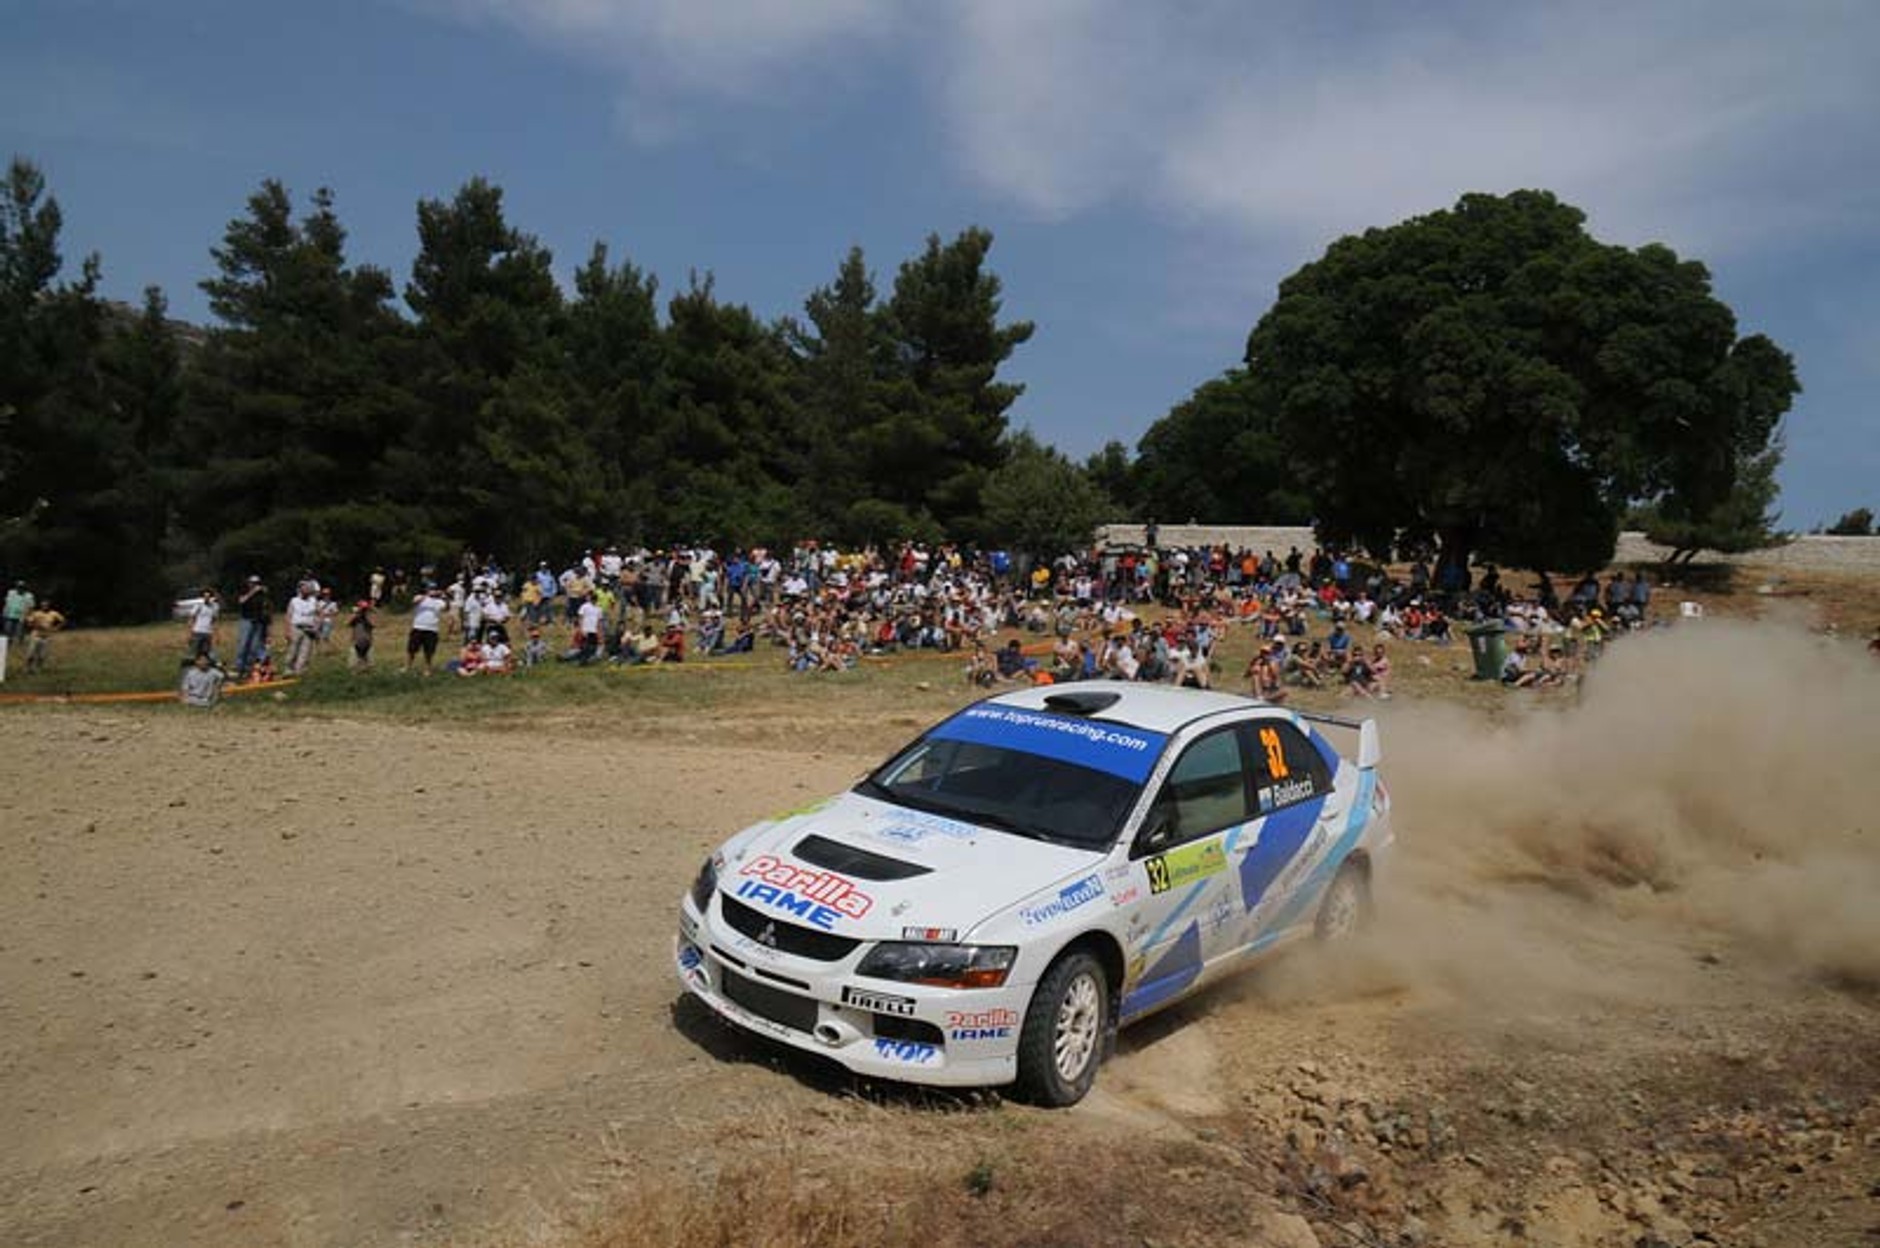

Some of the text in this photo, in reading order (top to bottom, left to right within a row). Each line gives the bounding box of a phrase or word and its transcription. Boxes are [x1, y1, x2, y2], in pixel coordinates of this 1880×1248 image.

[965, 707, 1148, 752] www.toprunracing.com
[1258, 727, 1289, 780] 32
[738, 855, 874, 920] Parilla
[1146, 857, 1169, 892] 32
[737, 880, 843, 930] IAME
[845, 985, 917, 1016] PIRELLI
[951, 1027, 1013, 1041] IAME
